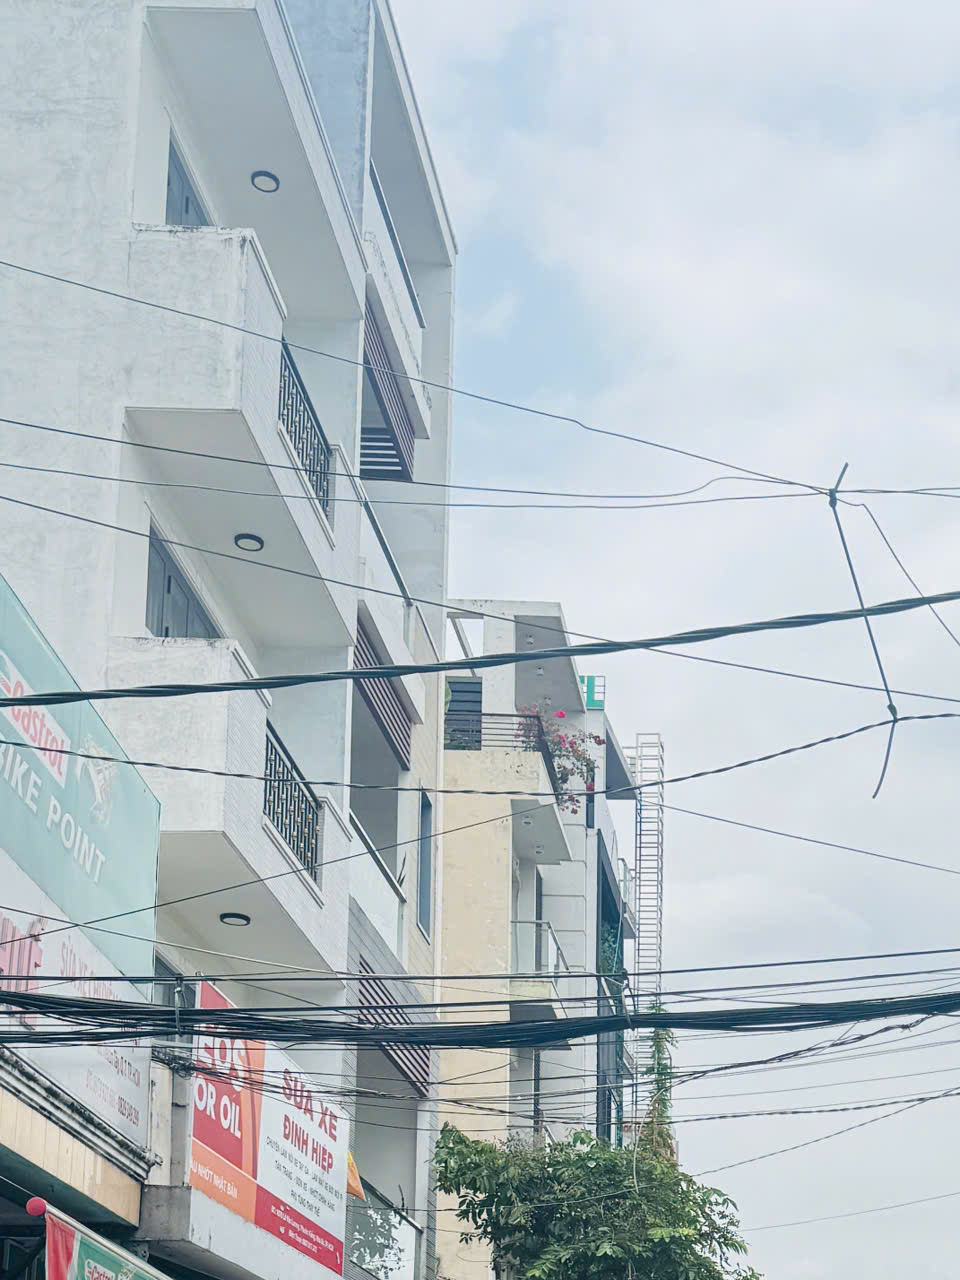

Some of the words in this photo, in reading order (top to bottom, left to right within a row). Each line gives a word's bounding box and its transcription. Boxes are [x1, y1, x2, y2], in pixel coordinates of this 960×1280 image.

[9, 680, 66, 777] Castrol
[46, 795, 106, 885] POINT
[219, 1095, 242, 1138] OIL
[318, 1101, 338, 1143] XE
